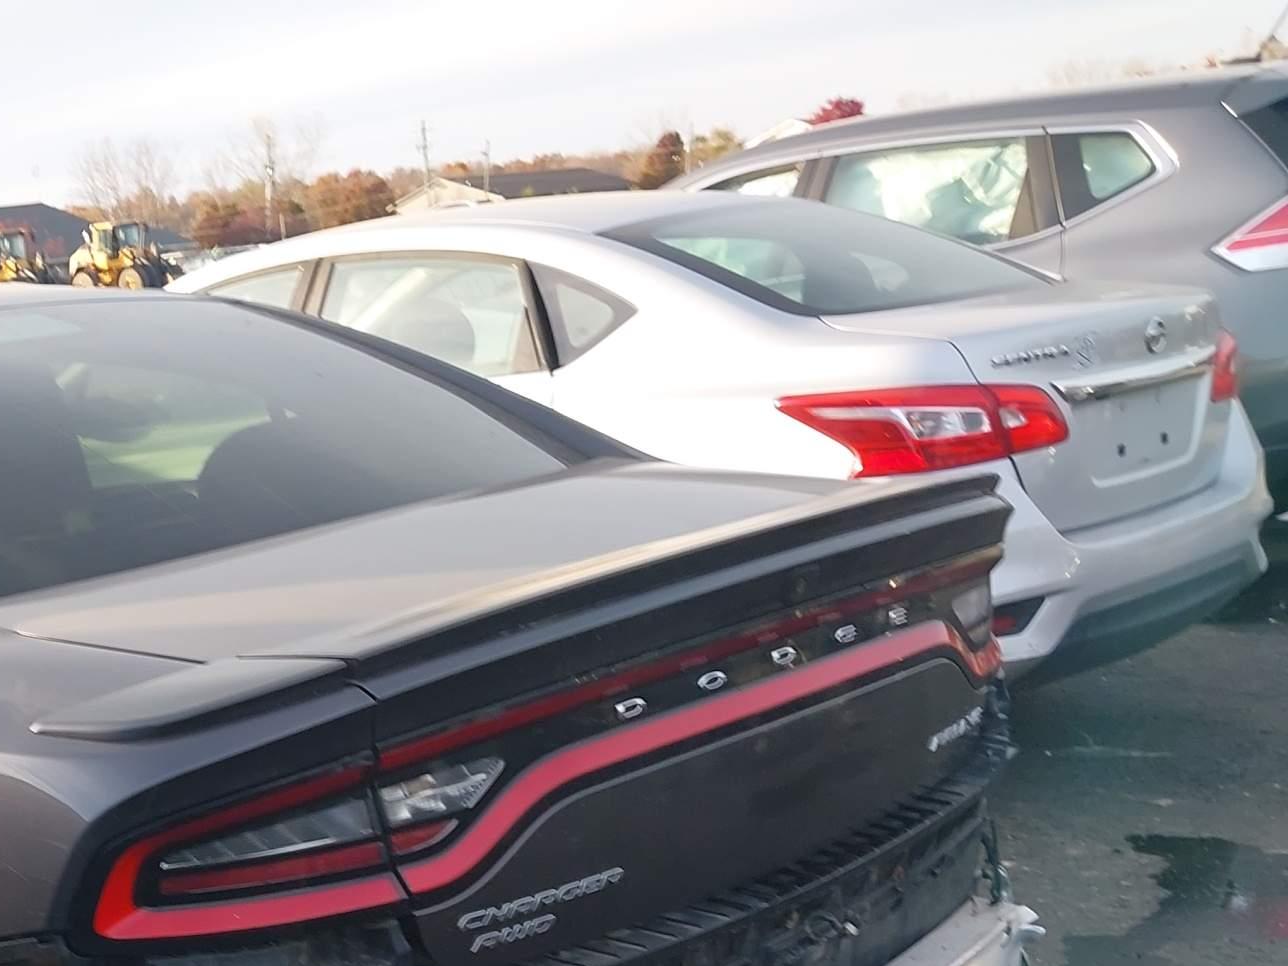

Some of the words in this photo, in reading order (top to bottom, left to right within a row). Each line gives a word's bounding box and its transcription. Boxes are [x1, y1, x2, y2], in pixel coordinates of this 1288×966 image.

[613, 606, 908, 720] DODGE
[457, 866, 625, 930] CHARGER
[470, 913, 557, 953] AWD
